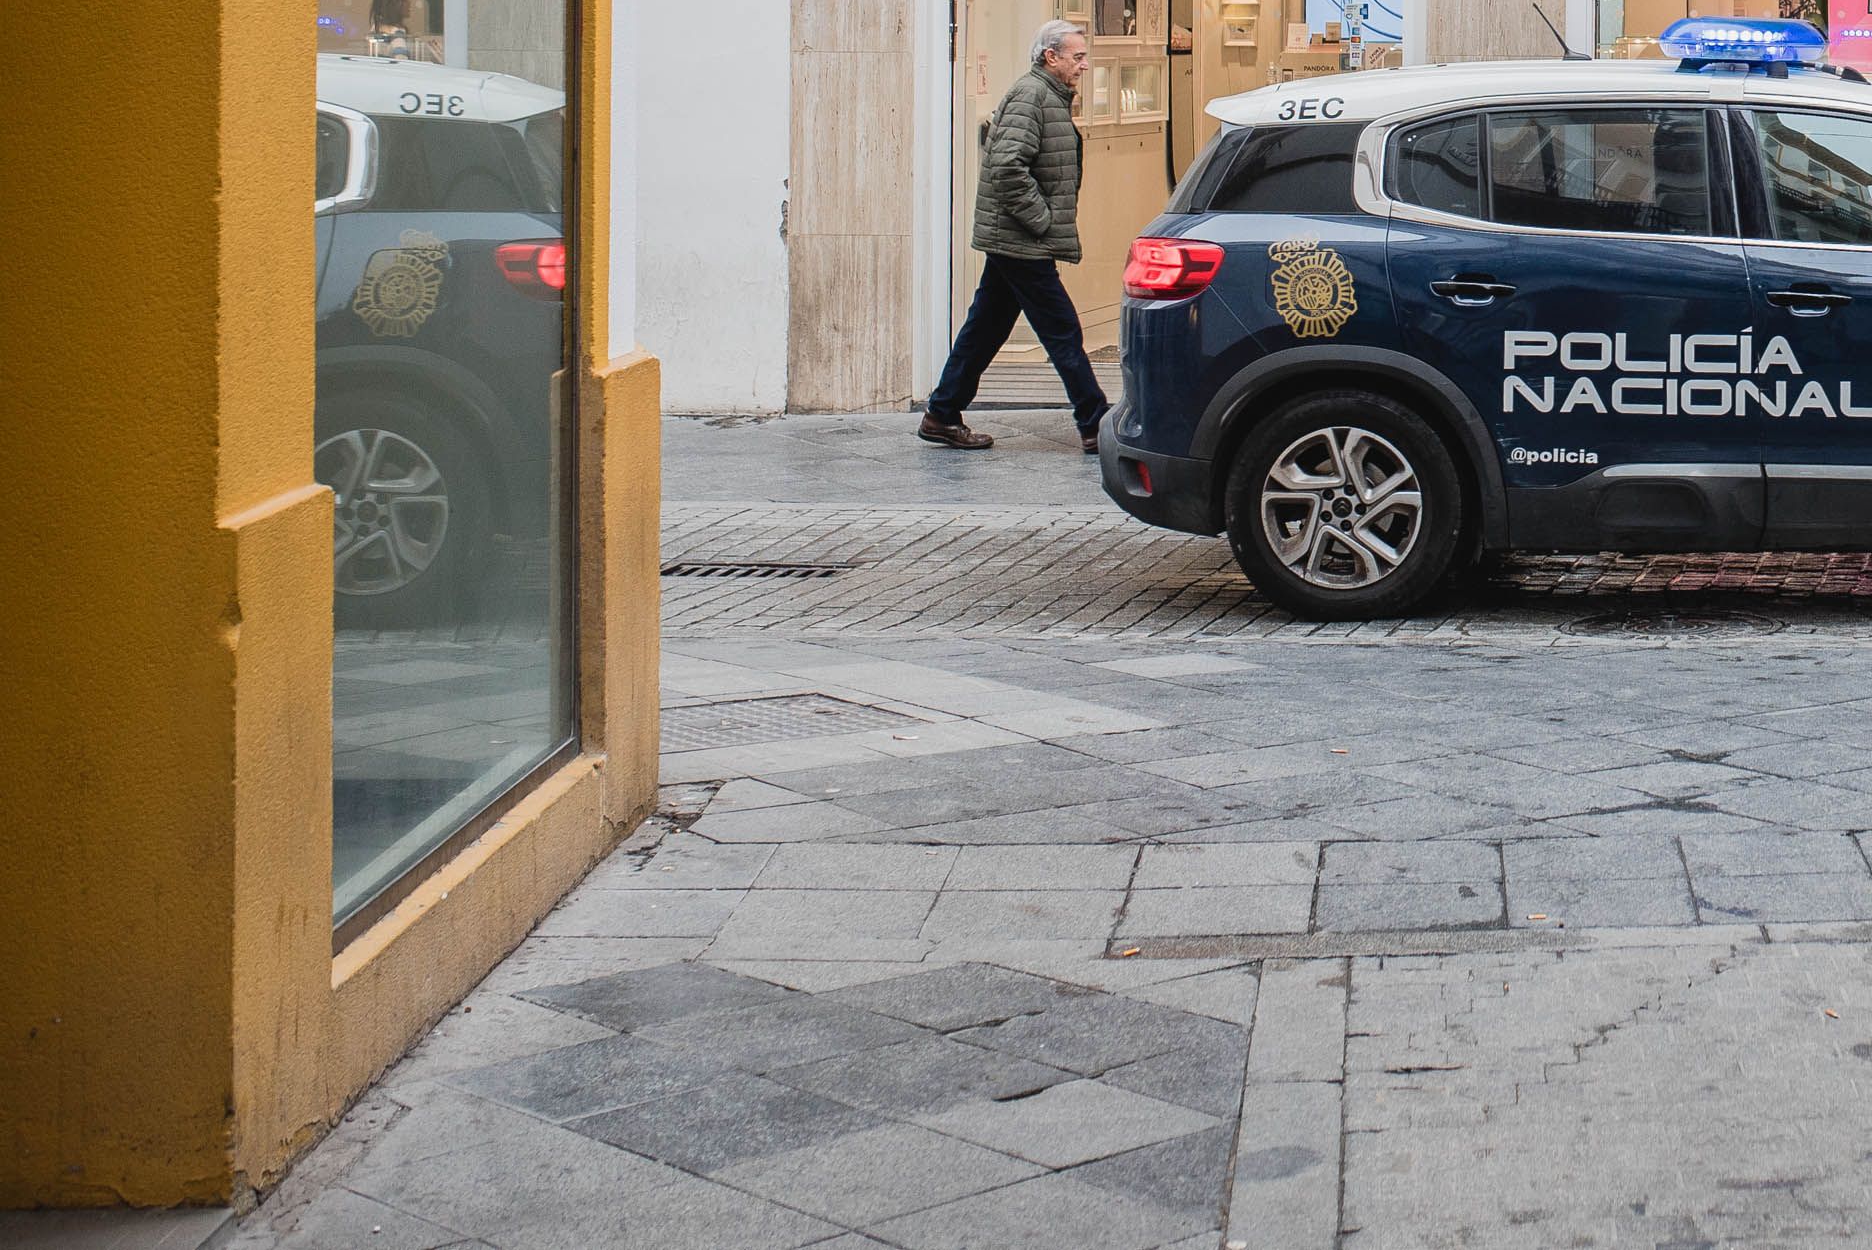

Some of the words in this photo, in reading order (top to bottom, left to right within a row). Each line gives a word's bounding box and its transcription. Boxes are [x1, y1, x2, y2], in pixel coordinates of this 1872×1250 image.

[1278, 97, 1345, 121] 3EC
[1503, 326, 1803, 375] POLICÍA
[1509, 447, 1599, 466] @policia
